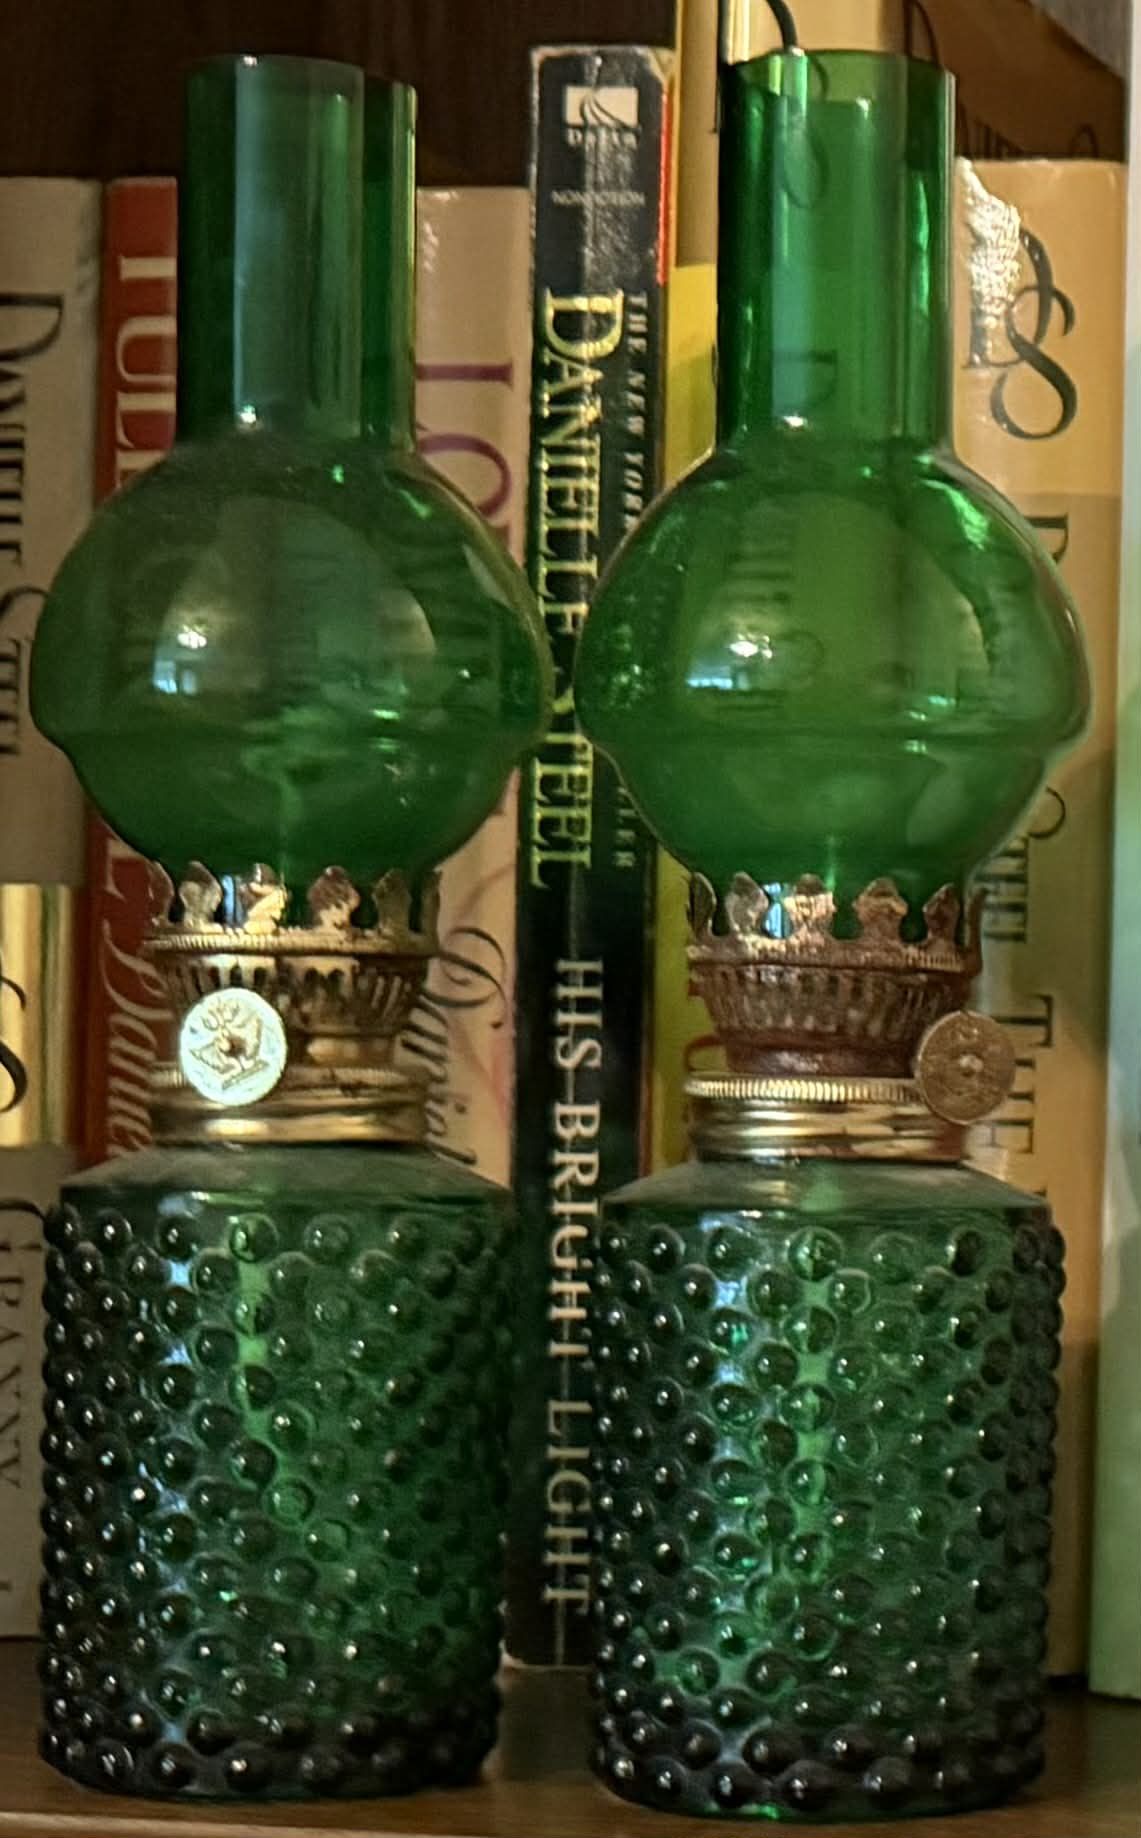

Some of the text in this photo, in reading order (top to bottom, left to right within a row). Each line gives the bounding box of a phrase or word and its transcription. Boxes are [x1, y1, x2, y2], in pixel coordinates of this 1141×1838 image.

[627, 291, 648, 356] THE
[625, 369, 646, 437] NEW
[531, 287, 625, 888] DANIELLE TEEL
[554, 958, 604, 1070] HIS
[545, 1398, 594, 1616] LIGHT
